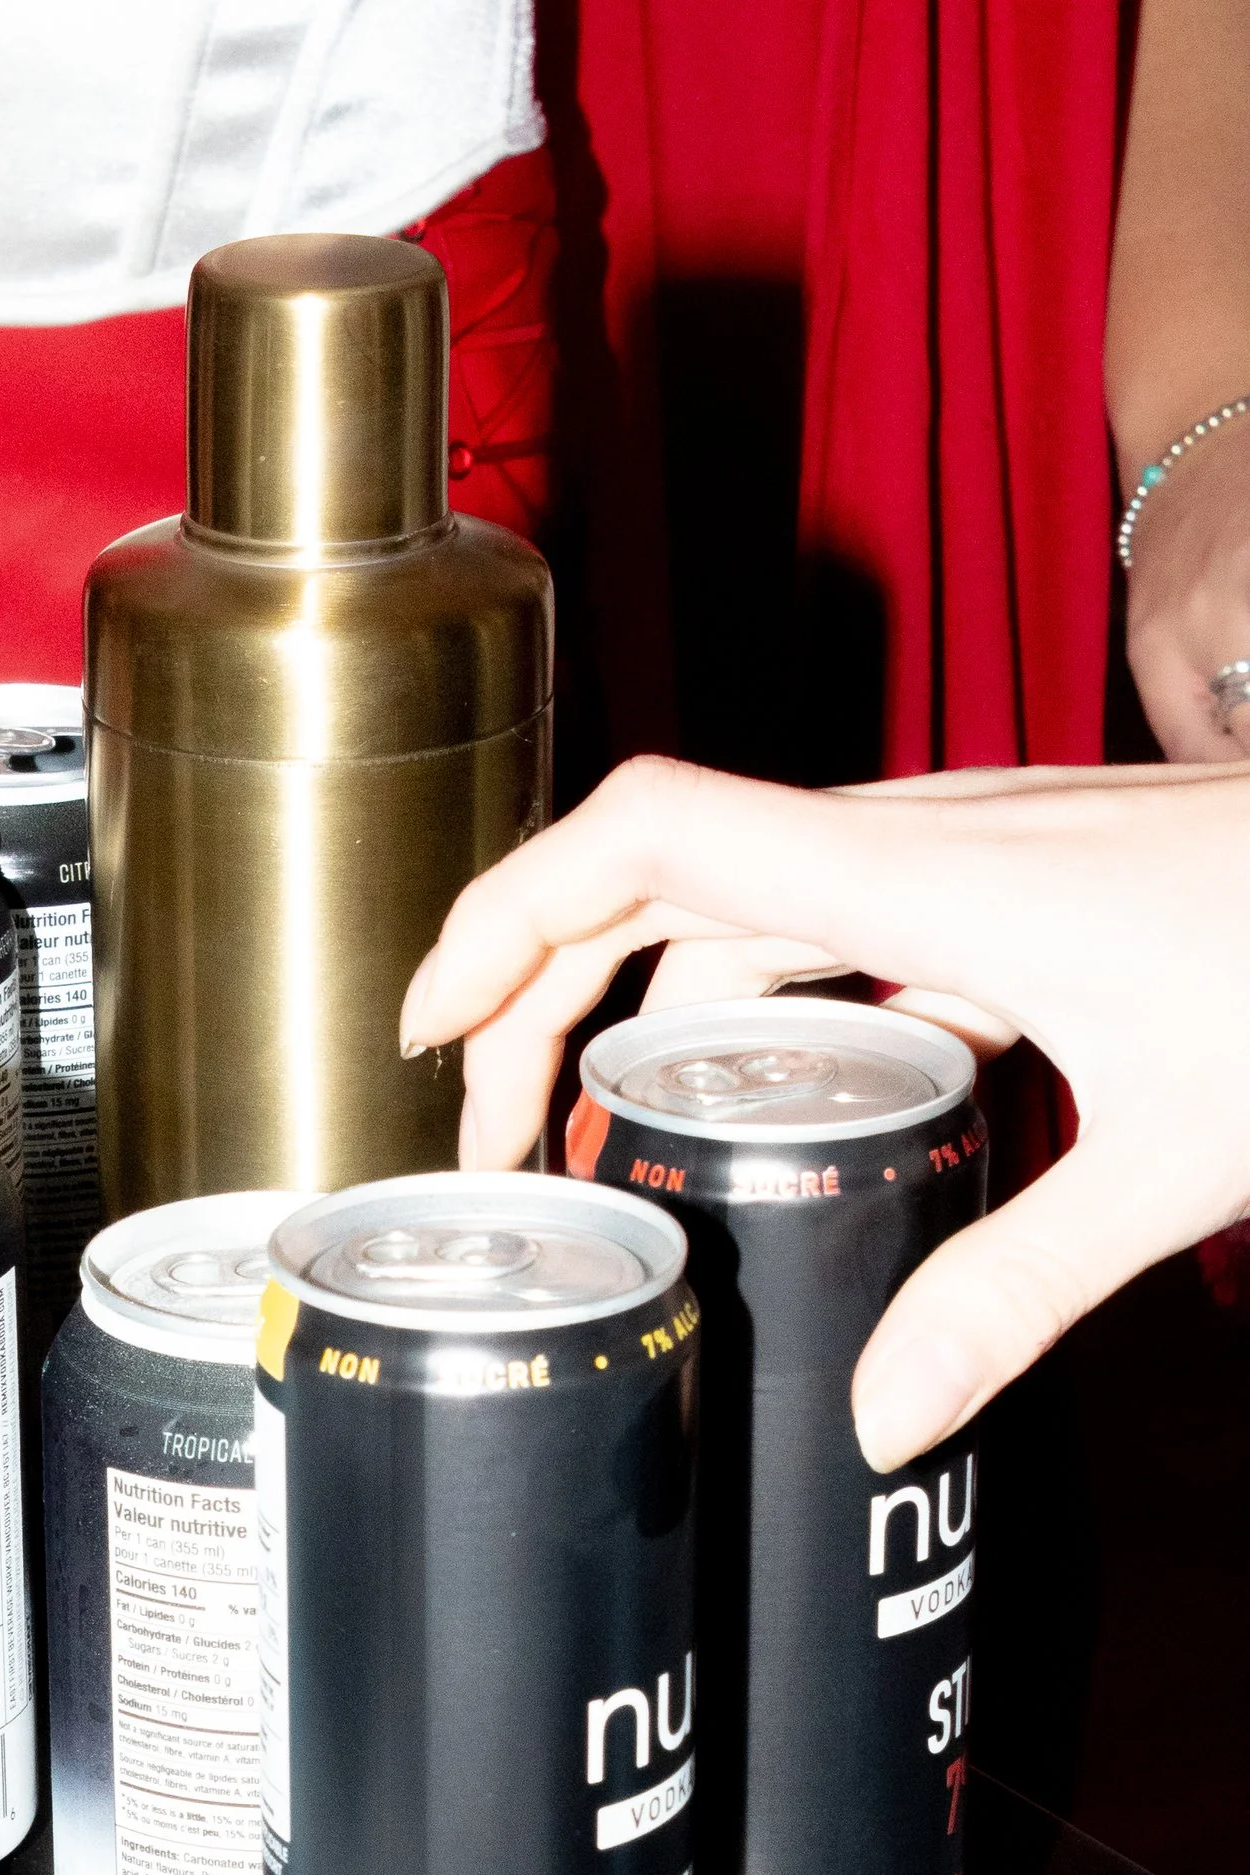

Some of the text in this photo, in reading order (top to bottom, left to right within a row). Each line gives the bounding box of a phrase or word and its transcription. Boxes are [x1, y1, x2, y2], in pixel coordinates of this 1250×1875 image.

[42, 956, 61, 967] can
[49, 968, 88, 981] canette
[66, 989, 87, 1003] 140
[629, 1158, 685, 1193] NON
[929, 1144, 959, 1174] 7%
[319, 1346, 381, 1386] NON
[640, 1330, 675, 1360] 7%
[163, 1431, 254, 1464] TROPICAL
[113, 1476, 242, 1515] Nutrition Facts
[113, 1501, 247, 1539] Valeur nutritive
[115, 1526, 166, 1549] Per can
[115, 1546, 198, 1574] pour canette
[115, 1570, 197, 1600] Calories 140
[6, 1594, 16, 1651] BEVERAGE
[116, 1599, 175, 1623] Fat Lipides
[116, 1619, 241, 1651] Carbohydrate Glucides
[128, 1637, 208, 1664] Sugars Sucres
[118, 1654, 210, 1683] Protein Protéines
[117, 1674, 243, 1707] Cholesterol Cholestérol
[118, 1694, 152, 1713] Sodium
[139, 1727, 212, 1749] significant source
[119, 1752, 145, 1768] Source
[209, 1770, 238, 1784] lipides
[188, 1751, 220, 1764] vitamin
[194, 1784, 232, 1798] vitamine
[120, 1836, 245, 1870] Ingredients: Carbonated
[121, 1851, 153, 1871] Natural
